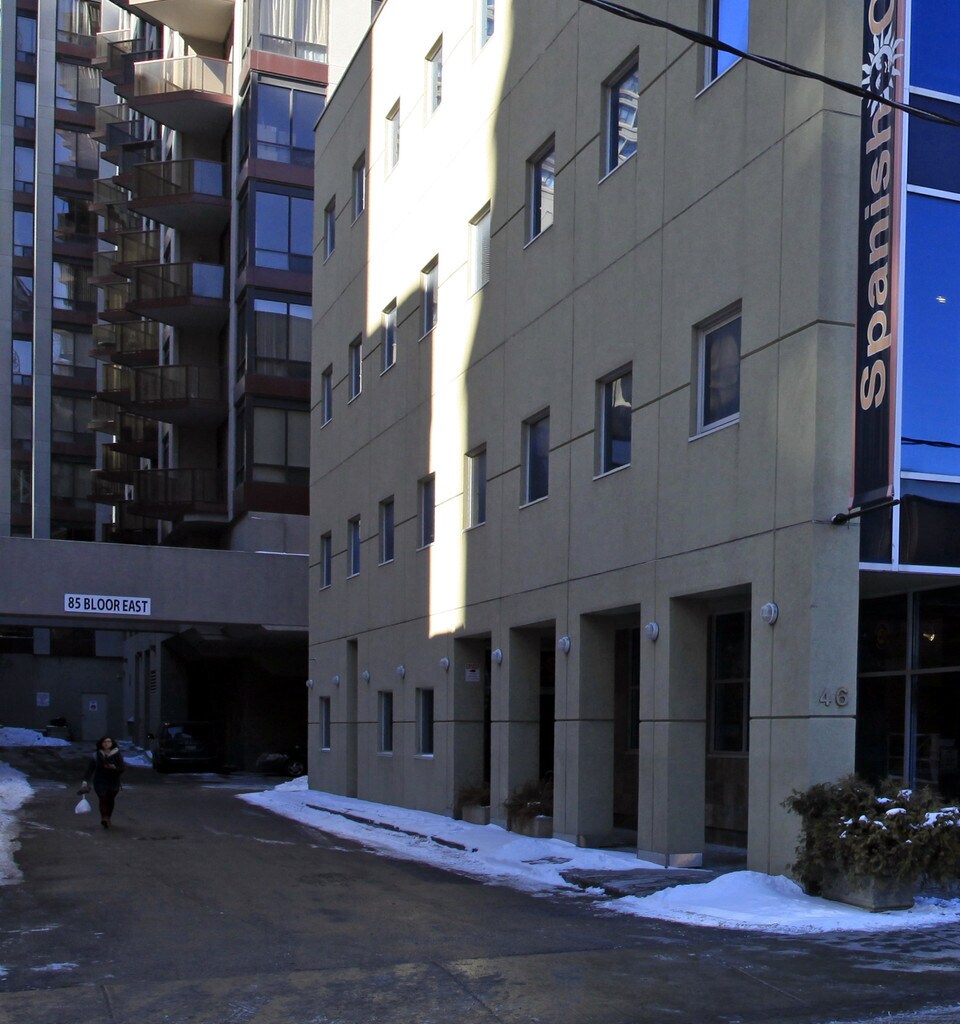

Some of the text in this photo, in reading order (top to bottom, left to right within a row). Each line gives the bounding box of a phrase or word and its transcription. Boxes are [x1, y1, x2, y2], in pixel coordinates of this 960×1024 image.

[860, 100, 892, 412] Spanish
[67, 596, 149, 614] 85 BLOOR EAST
[818, 687, 849, 707] 46
